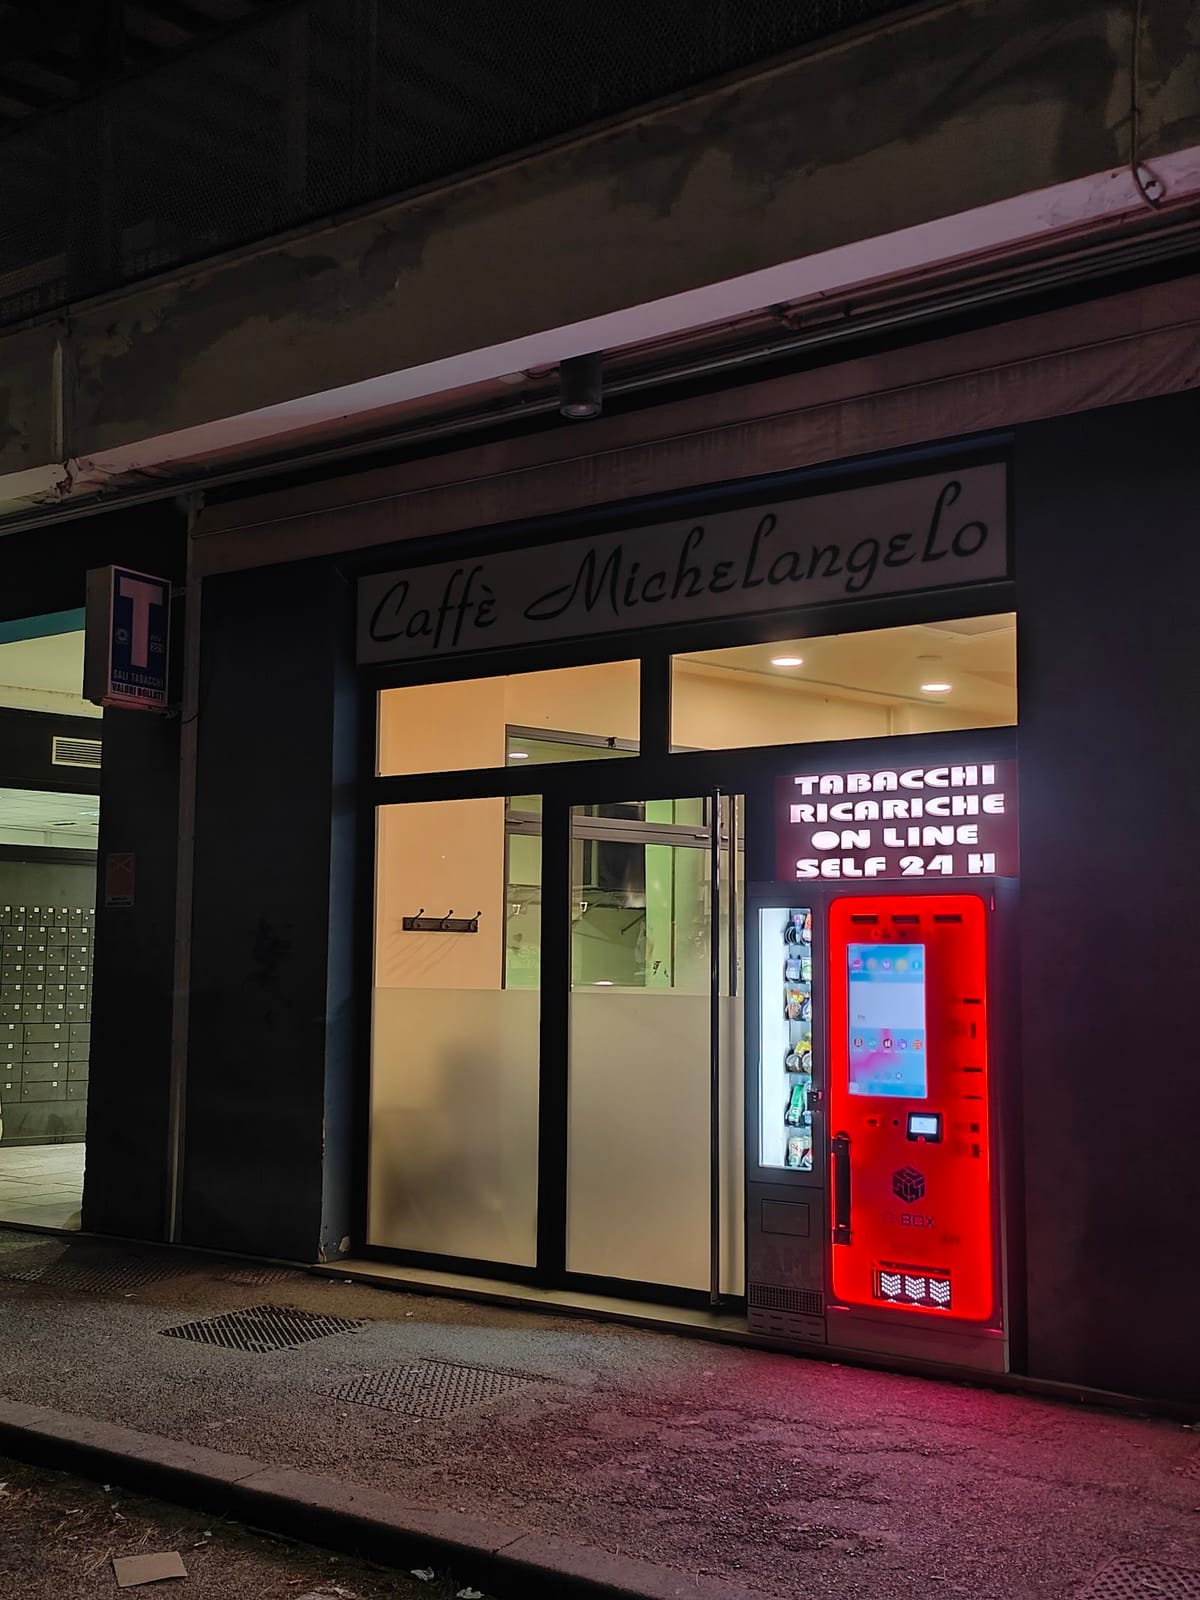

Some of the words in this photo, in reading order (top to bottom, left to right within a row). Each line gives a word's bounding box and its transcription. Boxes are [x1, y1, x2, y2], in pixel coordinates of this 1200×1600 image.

[369, 567, 496, 647] Caffè
[524, 482, 988, 621] Michelangelo
[120, 577, 163, 667] T
[113, 668, 129, 681] SALI
[794, 764, 995, 795] TABACCHI
[790, 793, 1005, 823] RICARICHE
[811, 829, 871, 850] ON
[883, 824, 979, 848] LINE
[796, 856, 886, 878] SELF
[899, 854, 953, 876] 24
[968, 853, 996, 874] H
